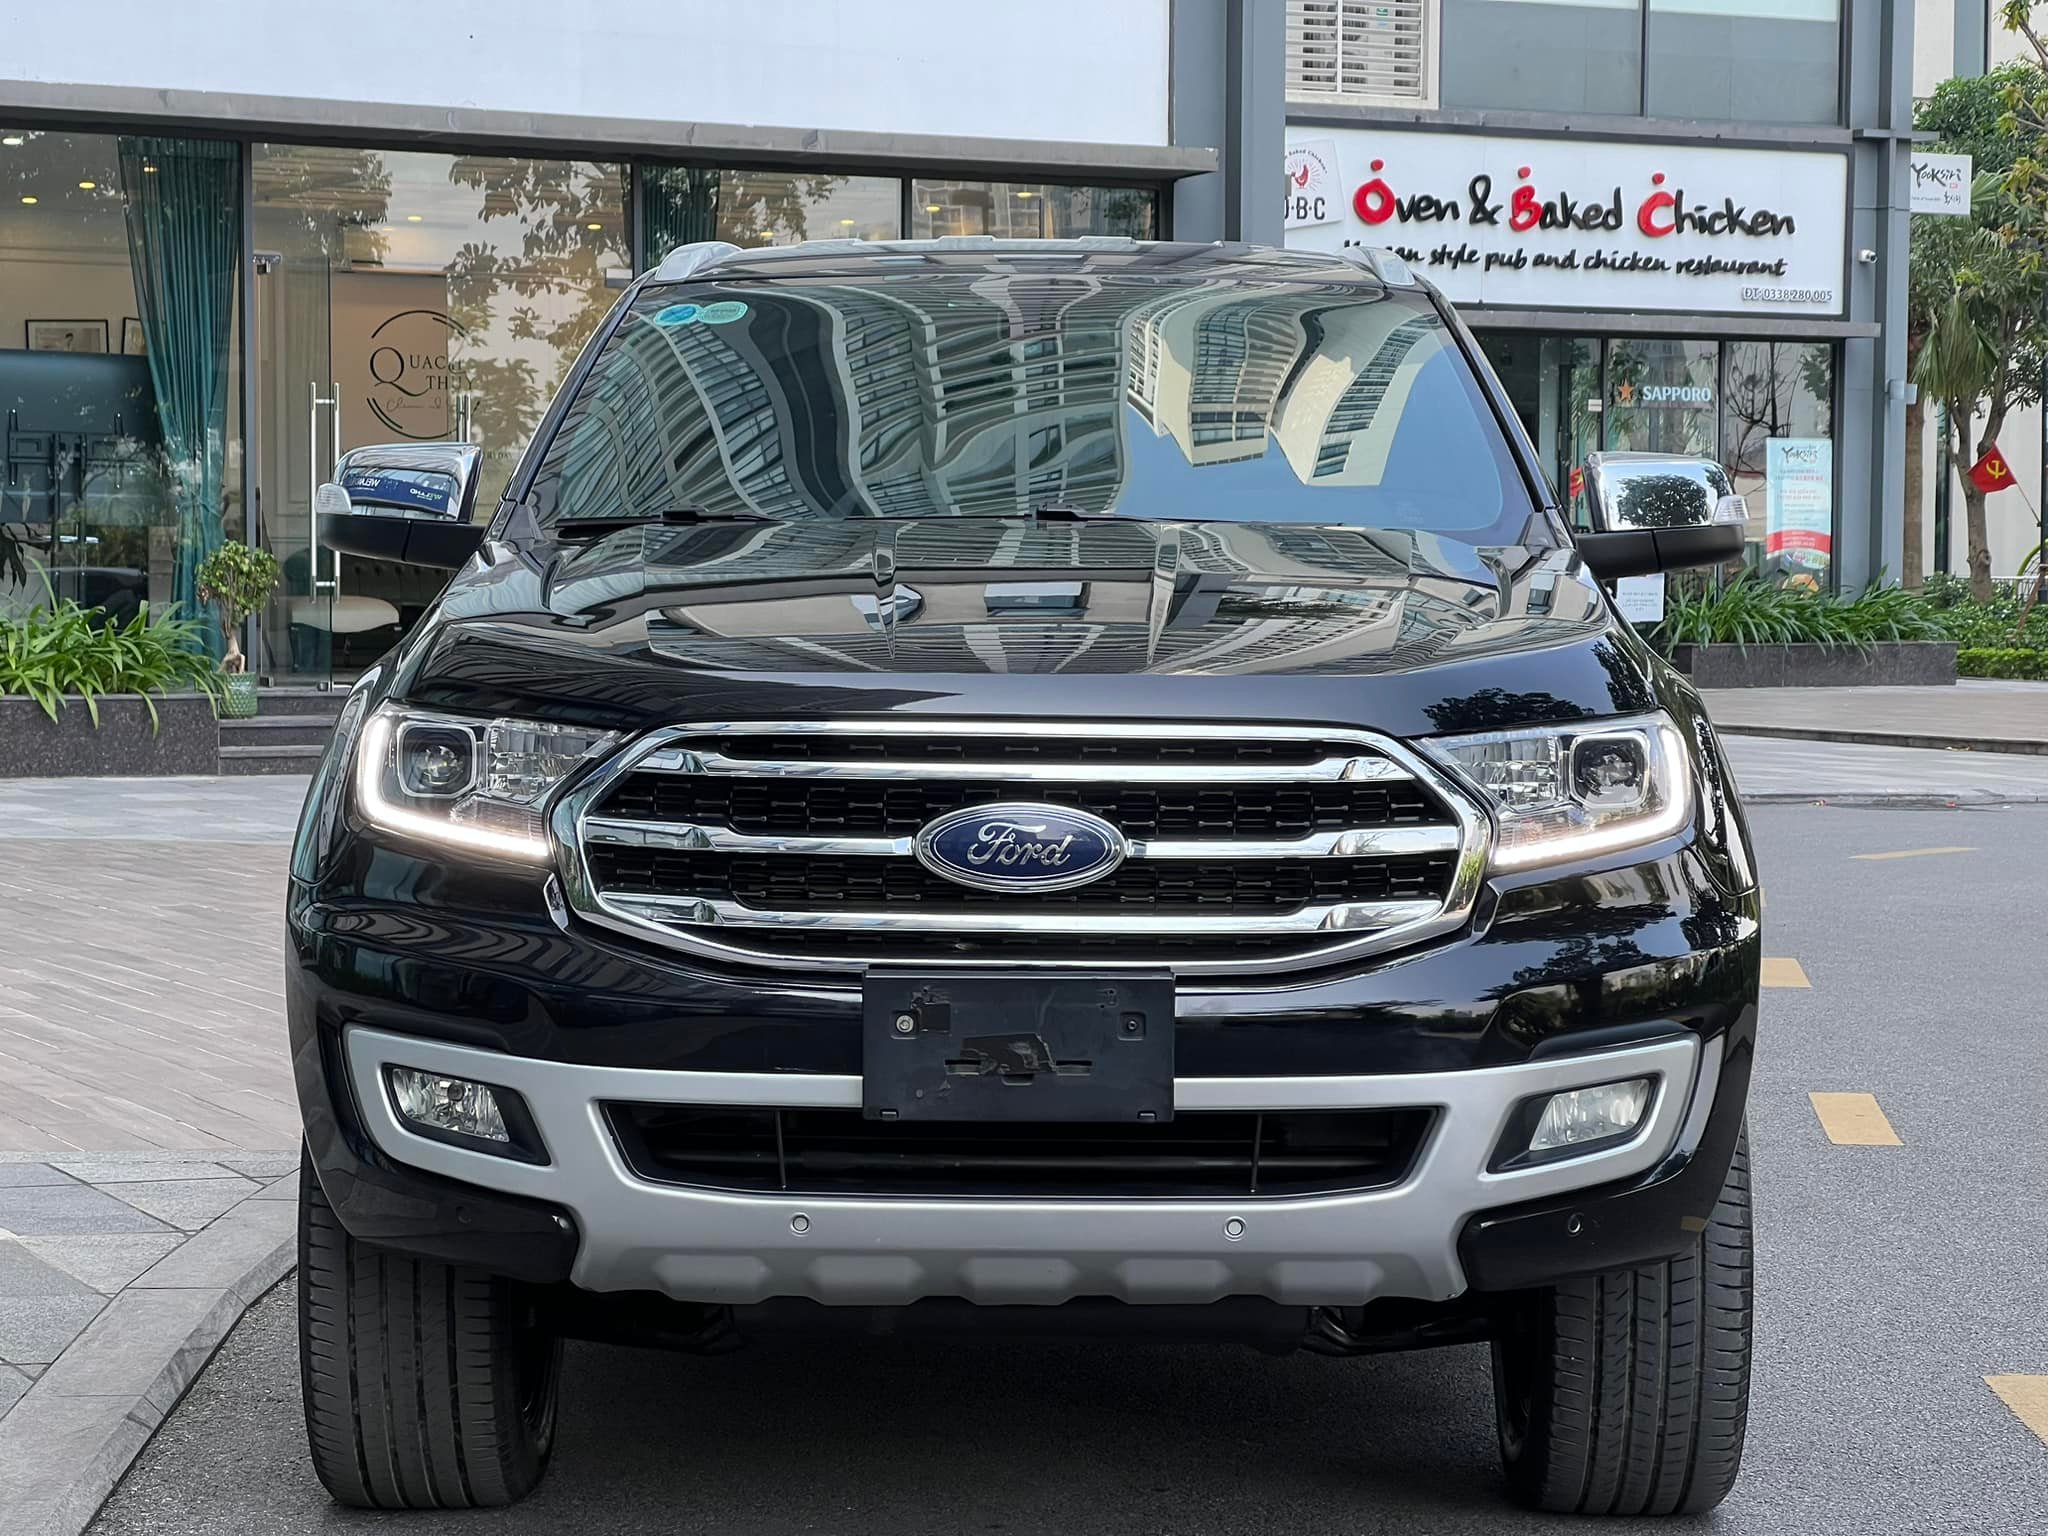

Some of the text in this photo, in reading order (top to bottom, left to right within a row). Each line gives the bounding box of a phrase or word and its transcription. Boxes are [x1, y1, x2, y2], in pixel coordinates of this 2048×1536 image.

[1353, 160, 1796, 238] Oven & Baked Chicken
[1428, 243, 1480, 270] style
[1484, 248, 1528, 272] pub
[1532, 250, 1581, 270] and
[1583, 249, 1671, 271] chicken
[1676, 254, 1788, 277] restaurant
[1642, 385, 1712, 402] SAPPORO
[966, 821, 1074, 866] Ford
